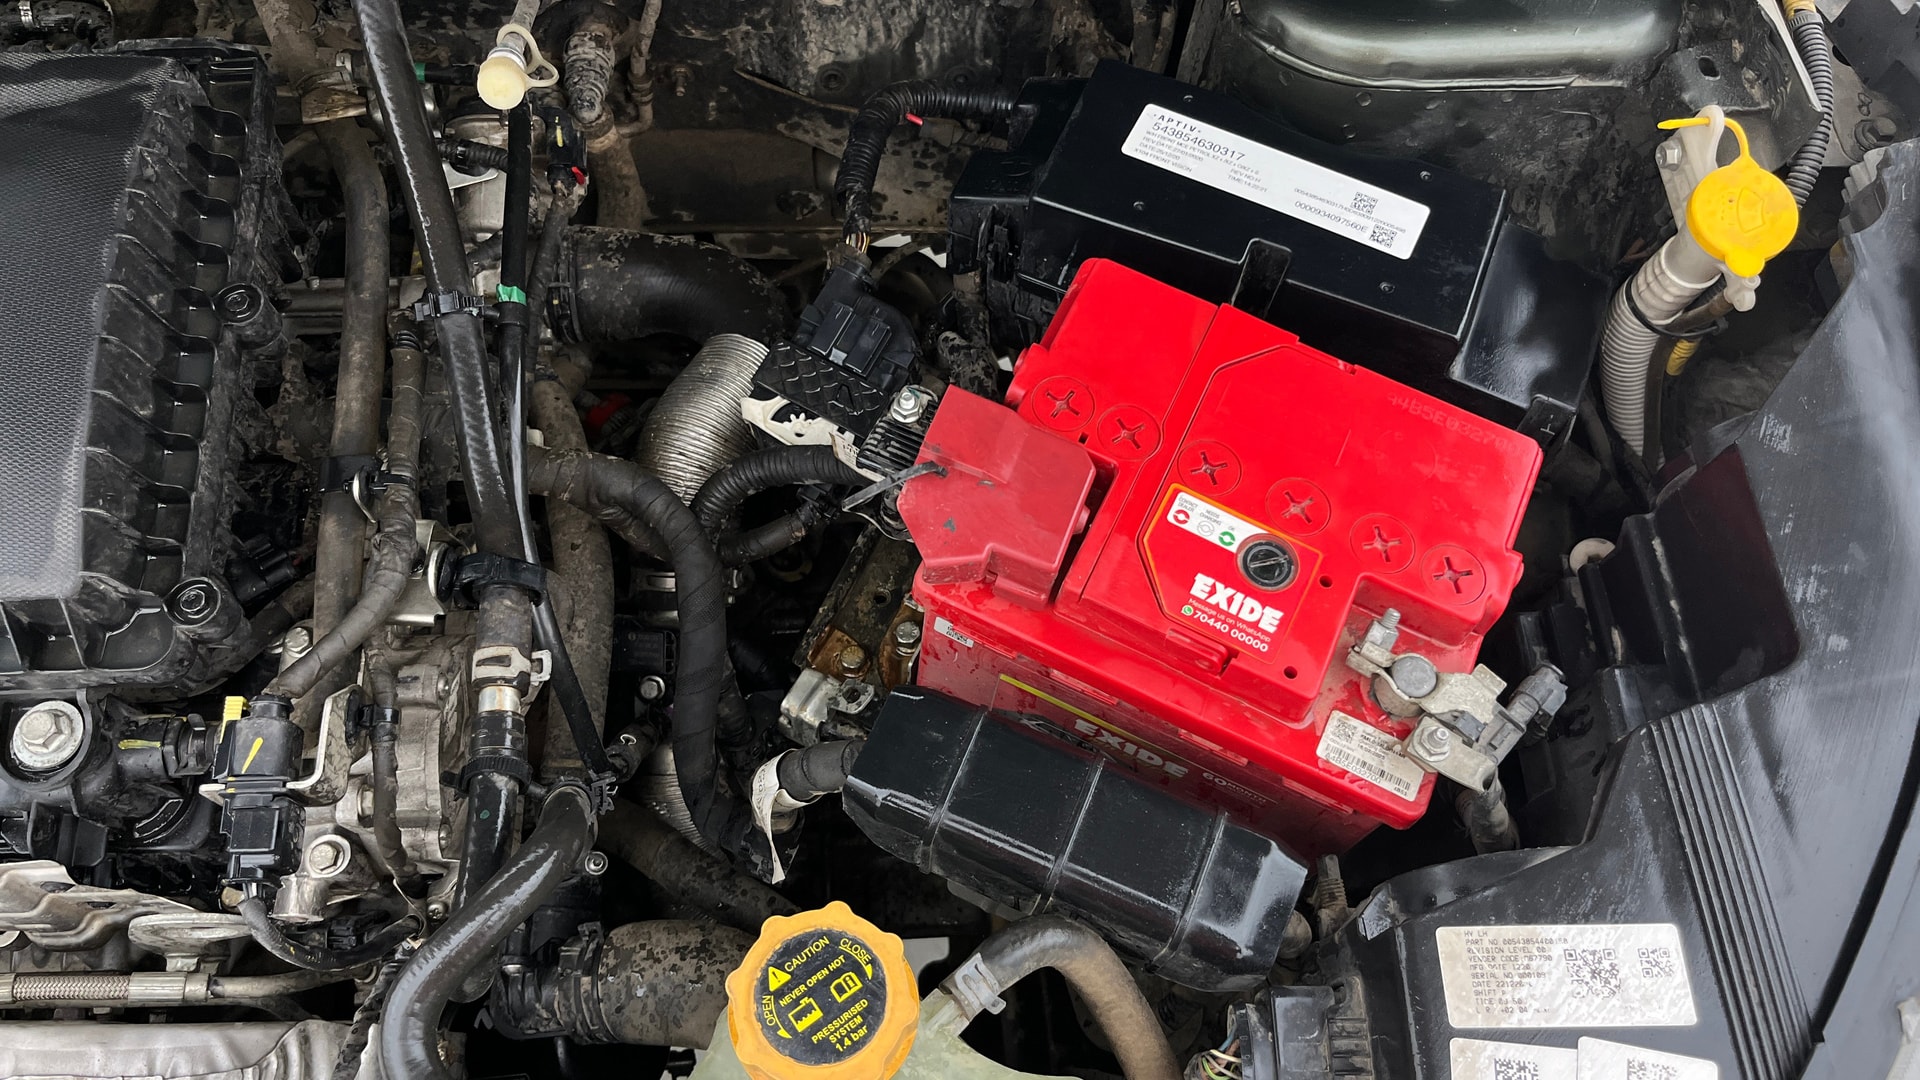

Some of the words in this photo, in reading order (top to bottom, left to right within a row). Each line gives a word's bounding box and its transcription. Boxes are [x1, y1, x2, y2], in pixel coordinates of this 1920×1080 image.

[1152, 121, 1245, 161] 543854630317
[1188, 598, 1217, 616] Message
[1217, 612, 1225, 620] us
[1226, 616, 1236, 624] on
[1236, 620, 1271, 643] WhatsApp
[1189, 573, 1284, 633] EXIDE
[1193, 610, 1228, 633] 70440
[1230, 628, 1269, 652] 00000
[1073, 719, 1189, 778] EXIDE
[784, 936, 830, 972] CAUTION
[840, 938, 872, 964] CLOSE
[779, 984, 808, 1007] NEVER
[806, 967, 829, 988] OPEN
[828, 954, 846, 972] HOT
[762, 995, 776, 1026] OPEN
[811, 999, 868, 1044] PRESSURISED
[829, 1015, 863, 1043] SYSTEM
[835, 1037, 852, 1052] 1.4
[851, 1025, 868, 1041] bar
